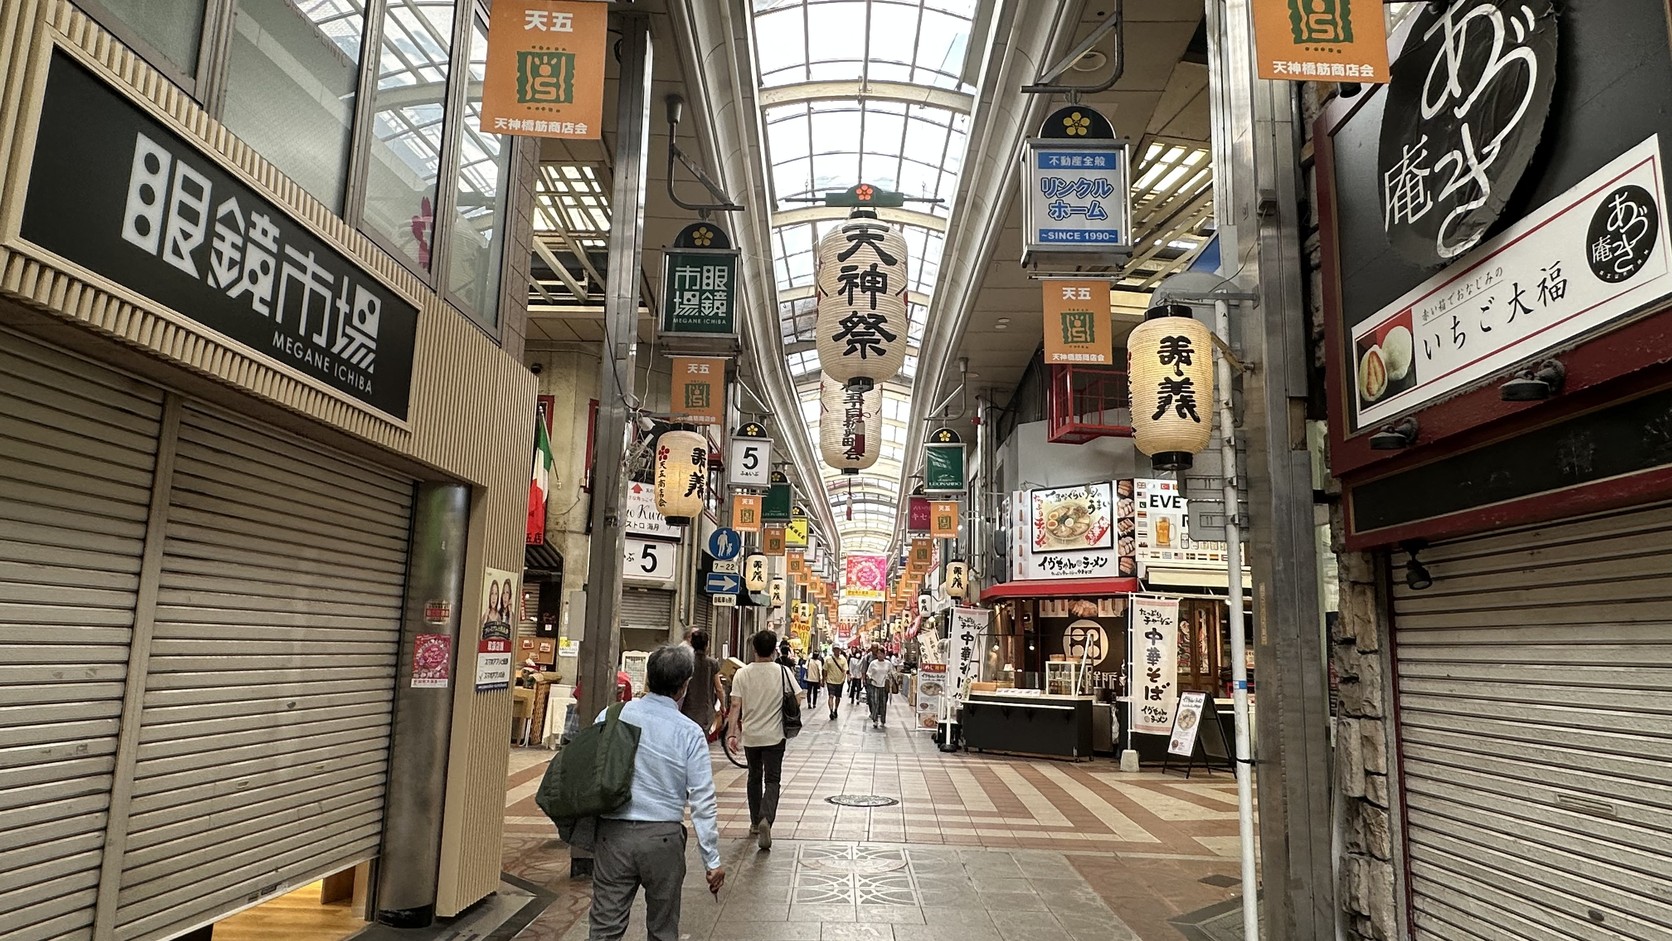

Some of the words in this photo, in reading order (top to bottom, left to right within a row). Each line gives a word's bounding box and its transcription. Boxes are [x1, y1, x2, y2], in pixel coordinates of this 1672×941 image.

[524, 9, 574, 32] 天五
[1272, 60, 1374, 77] 天神橋筋商店会
[494, 117, 588, 135] 天神橋筋商店会
[1049, 155, 1106, 167] 不動産全般
[1040, 176, 1114, 199] リンクル
[1384, 134, 1433, 232] 庵
[1048, 200, 1108, 221] ホーム
[121, 131, 382, 374] 眼鏡市場
[1592, 234, 1613, 264] 庵
[832, 223, 898, 360] 天神祭
[1062, 286, 1092, 300] 天五
[1421, 266, 1504, 321] 赤い箱でおなじみの
[1423, 260, 1568, 360] いちご大福
[272, 330, 330, 372] MEGANE
[333, 361, 373, 395] ICHIBA
[687, 363, 710, 374] 天五
[742, 446, 759, 470] 5
[640, 543, 658, 573] 5
[1082, 556, 1108, 568] ラーメン
[1144, 627, 1171, 701] 中華そば
